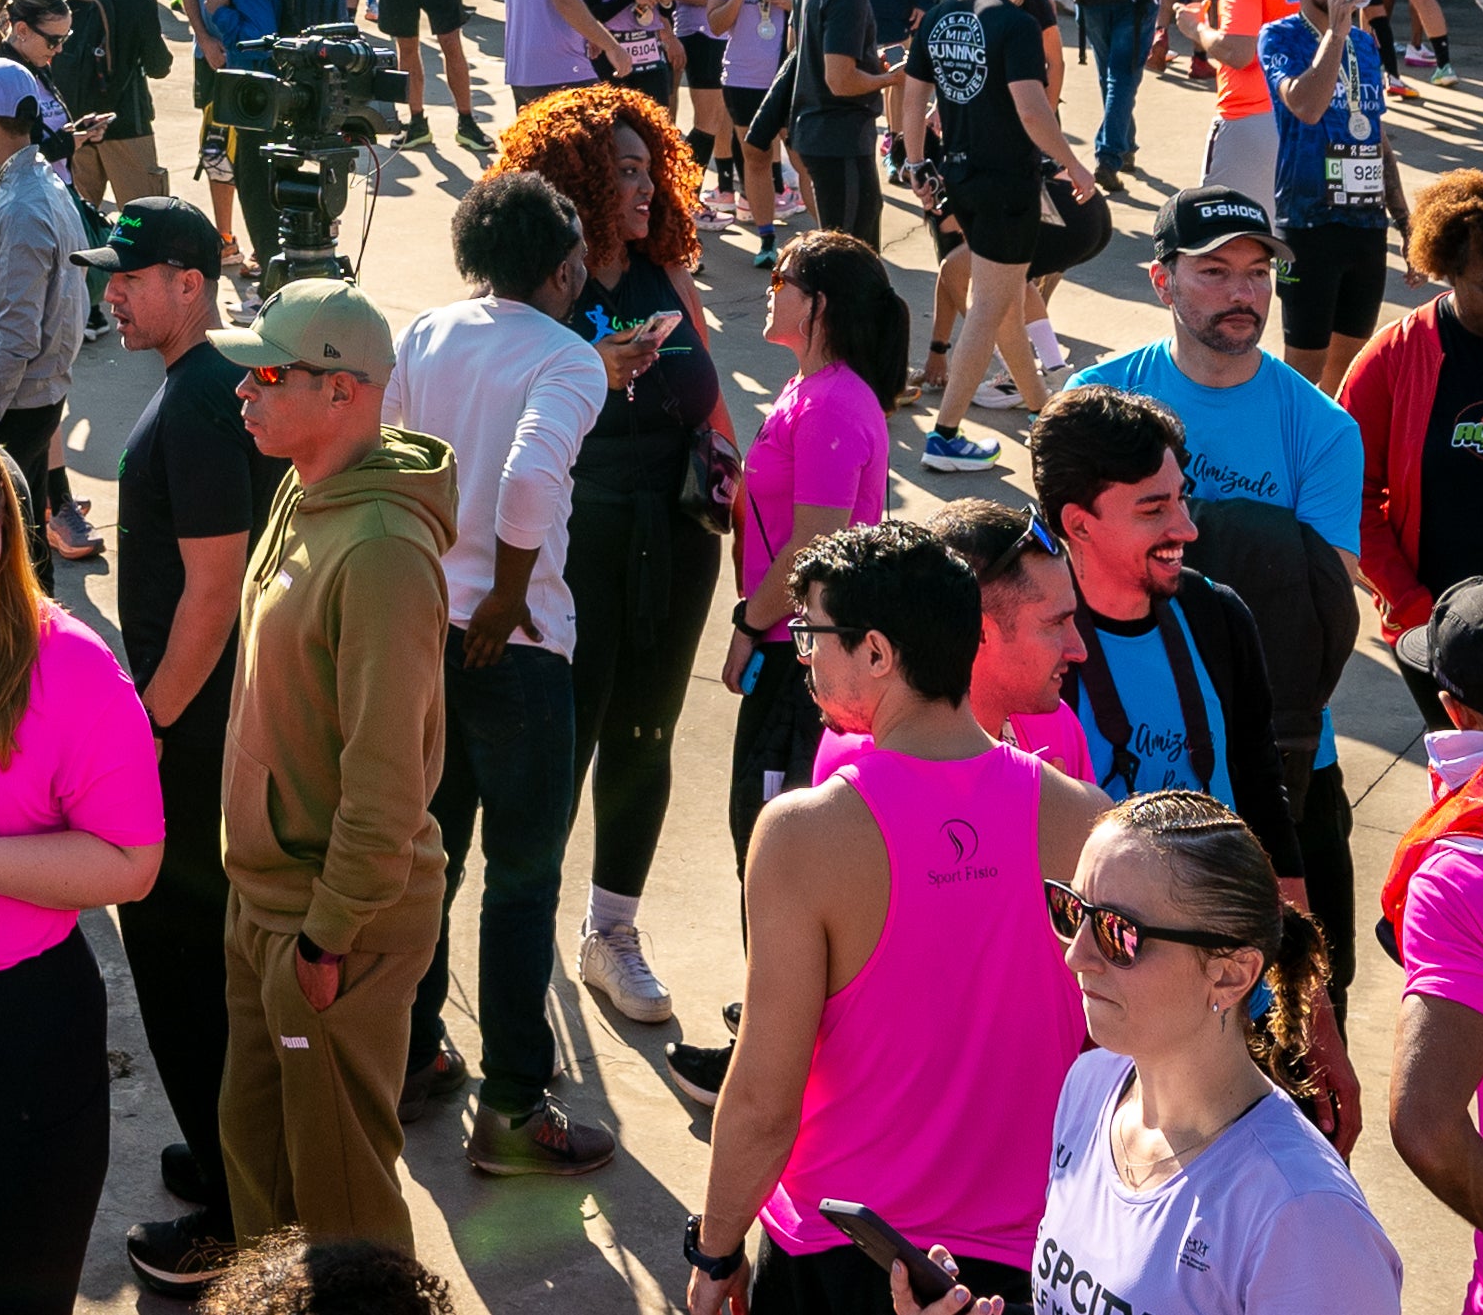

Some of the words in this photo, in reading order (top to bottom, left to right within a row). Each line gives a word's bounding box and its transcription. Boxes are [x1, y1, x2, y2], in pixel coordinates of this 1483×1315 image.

[1200, 202, 1266, 225] G-SHOCK
[1194, 455, 1280, 500] Amizade
[926, 869, 964, 890] Sport
[963, 865, 999, 884] Fisio
